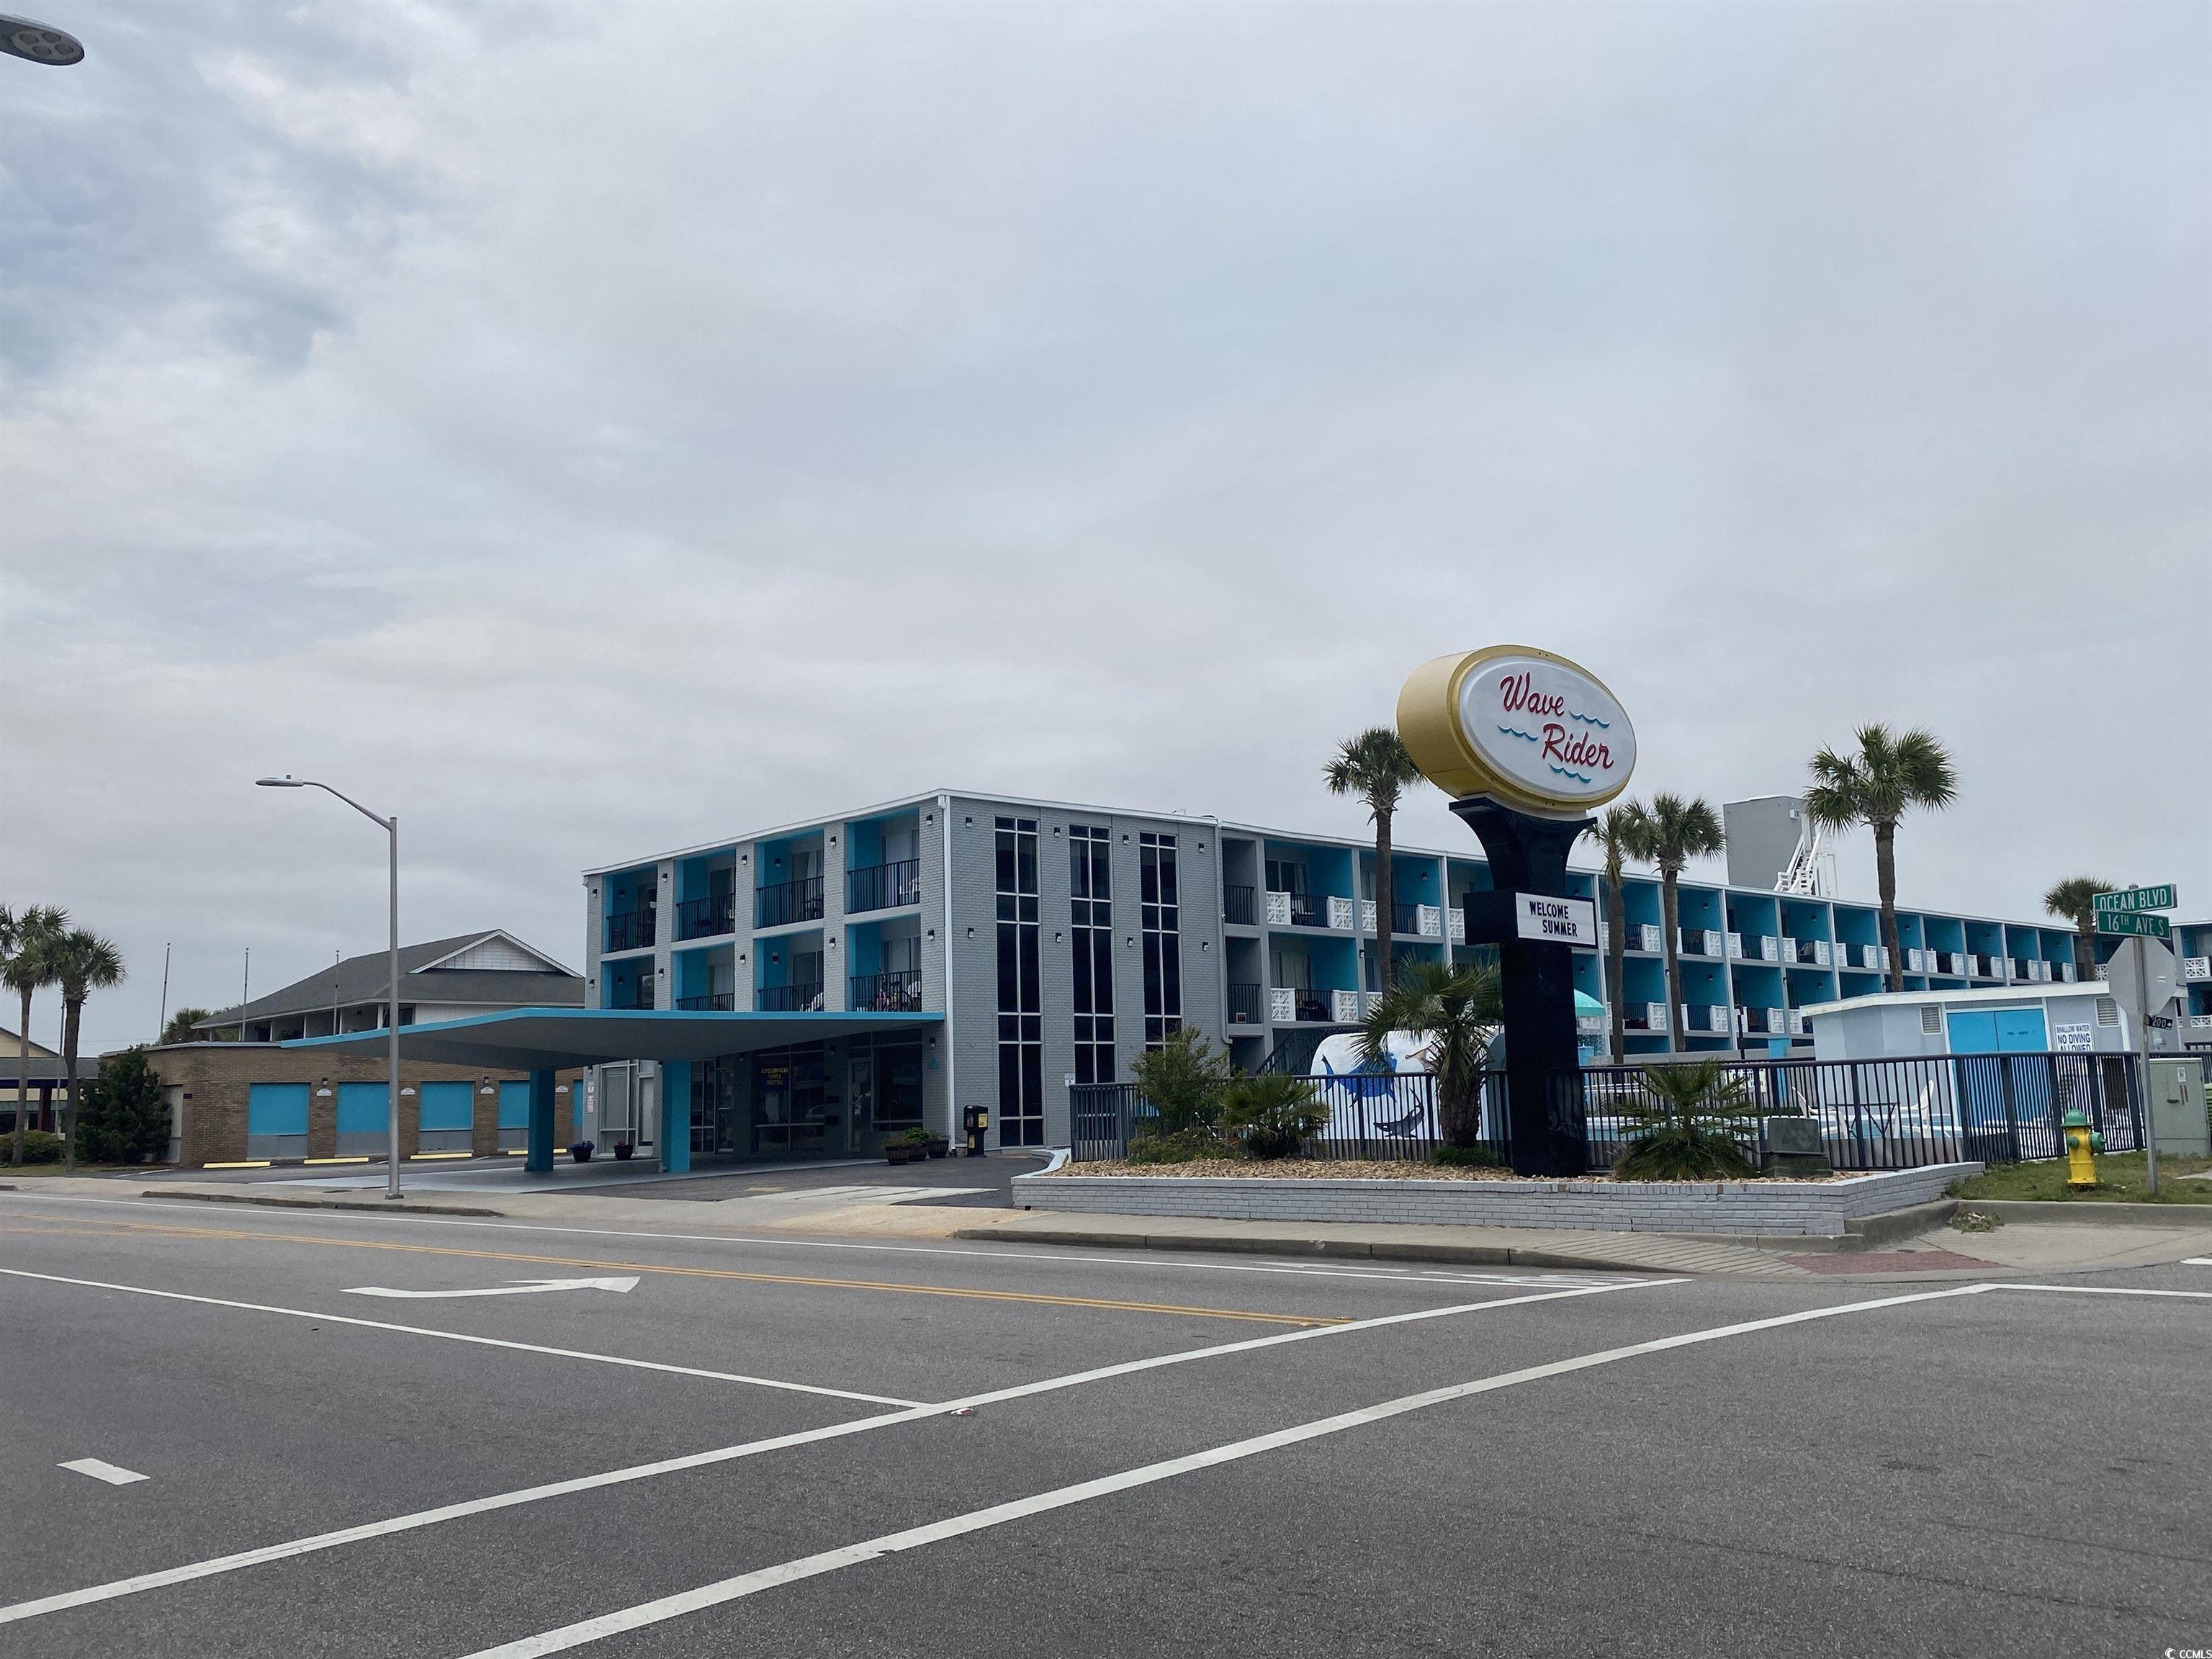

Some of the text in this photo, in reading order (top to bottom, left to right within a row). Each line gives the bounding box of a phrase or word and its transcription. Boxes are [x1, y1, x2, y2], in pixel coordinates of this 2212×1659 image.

[1500, 671, 1565, 716] Wave
[1542, 723, 1614, 769] Rider
[2100, 888, 2167, 911] OCEAN BLVD
[1529, 901, 1568, 919] WELCOME
[1542, 920, 1578, 937] SUMMER
[2107, 914, 2164, 936] 16TH AVE S
[2152, 1017, 2167, 1028] 200
[2057, 1033, 2090, 1044] NO DIVING
